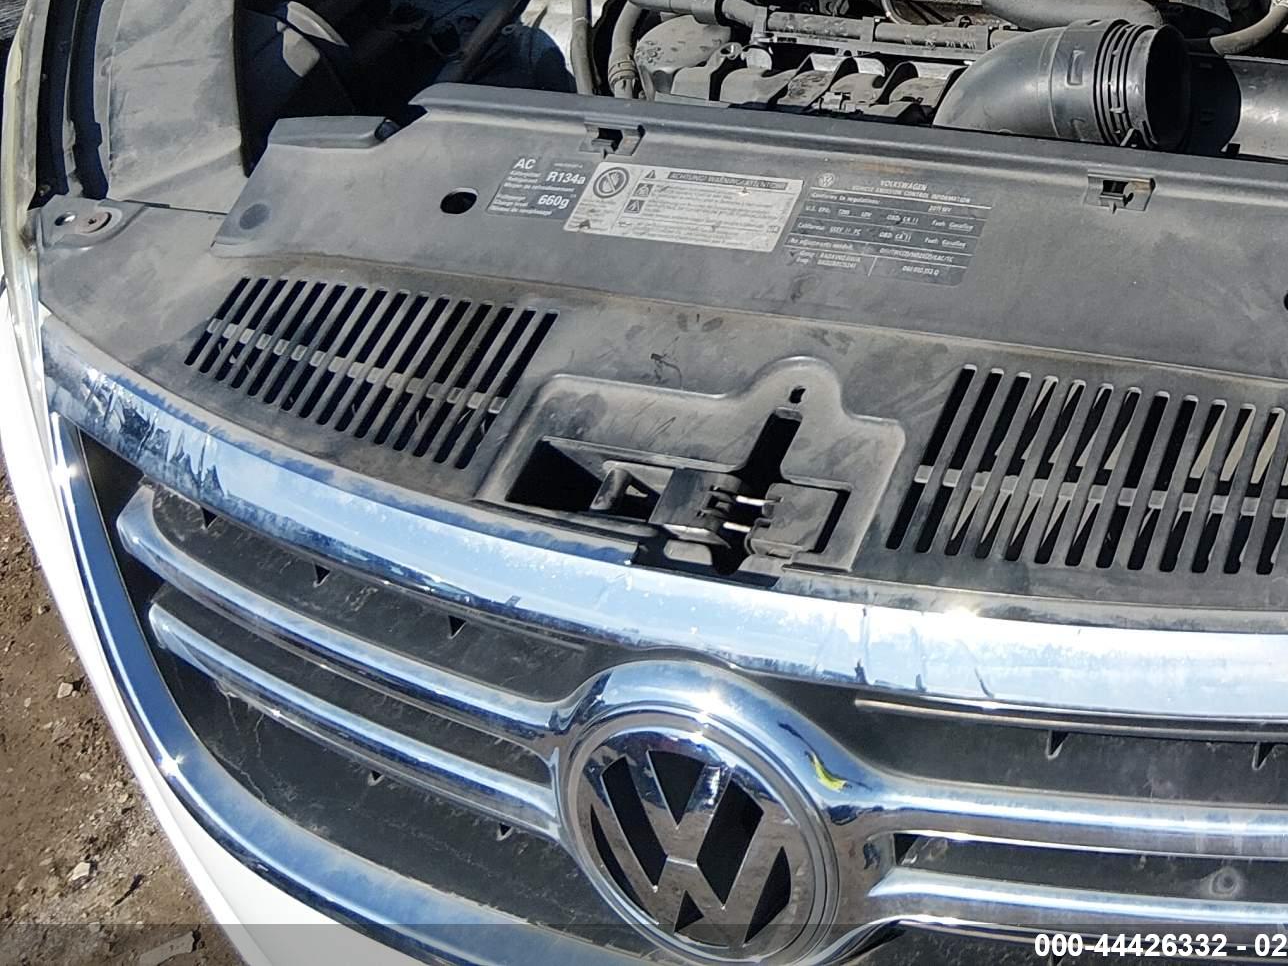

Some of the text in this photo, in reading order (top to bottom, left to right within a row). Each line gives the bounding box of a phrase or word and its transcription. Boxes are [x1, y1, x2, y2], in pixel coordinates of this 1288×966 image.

[513, 158, 536, 169] AC
[546, 171, 586, 185] R134a
[880, 180, 928, 191] VOLKSWAGEN
[537, 194, 570, 209] 660g
[903, 190, 930, 199] CONTROL
[931, 193, 971, 204] INFORMATION
